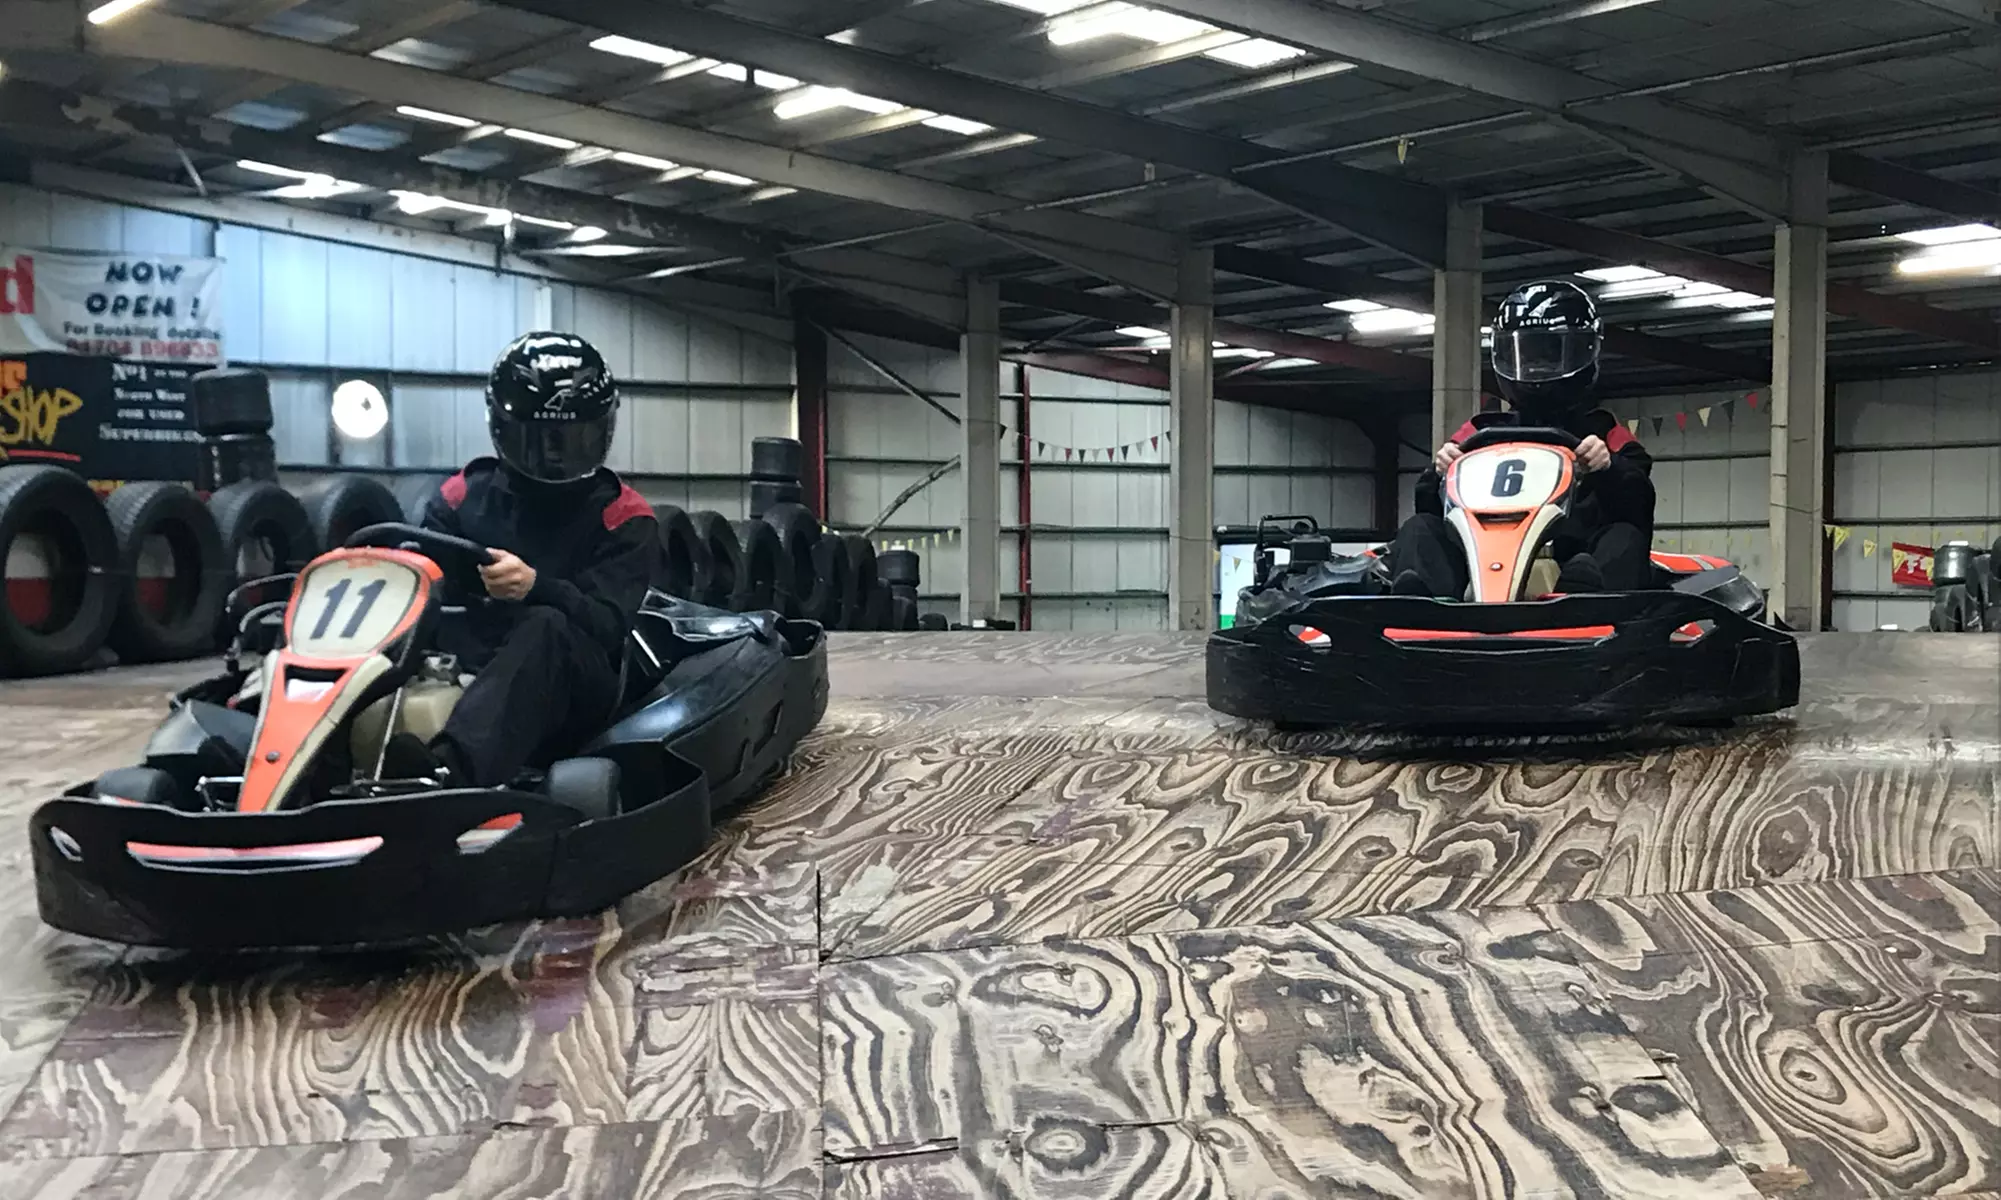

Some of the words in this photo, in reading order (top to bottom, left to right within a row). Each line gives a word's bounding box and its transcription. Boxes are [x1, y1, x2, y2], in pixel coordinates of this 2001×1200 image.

[105, 261, 183, 283] NOW
[85, 293, 175, 317] OPEN
[1490, 458, 1527, 498] 6
[309, 578, 387, 640] 11
